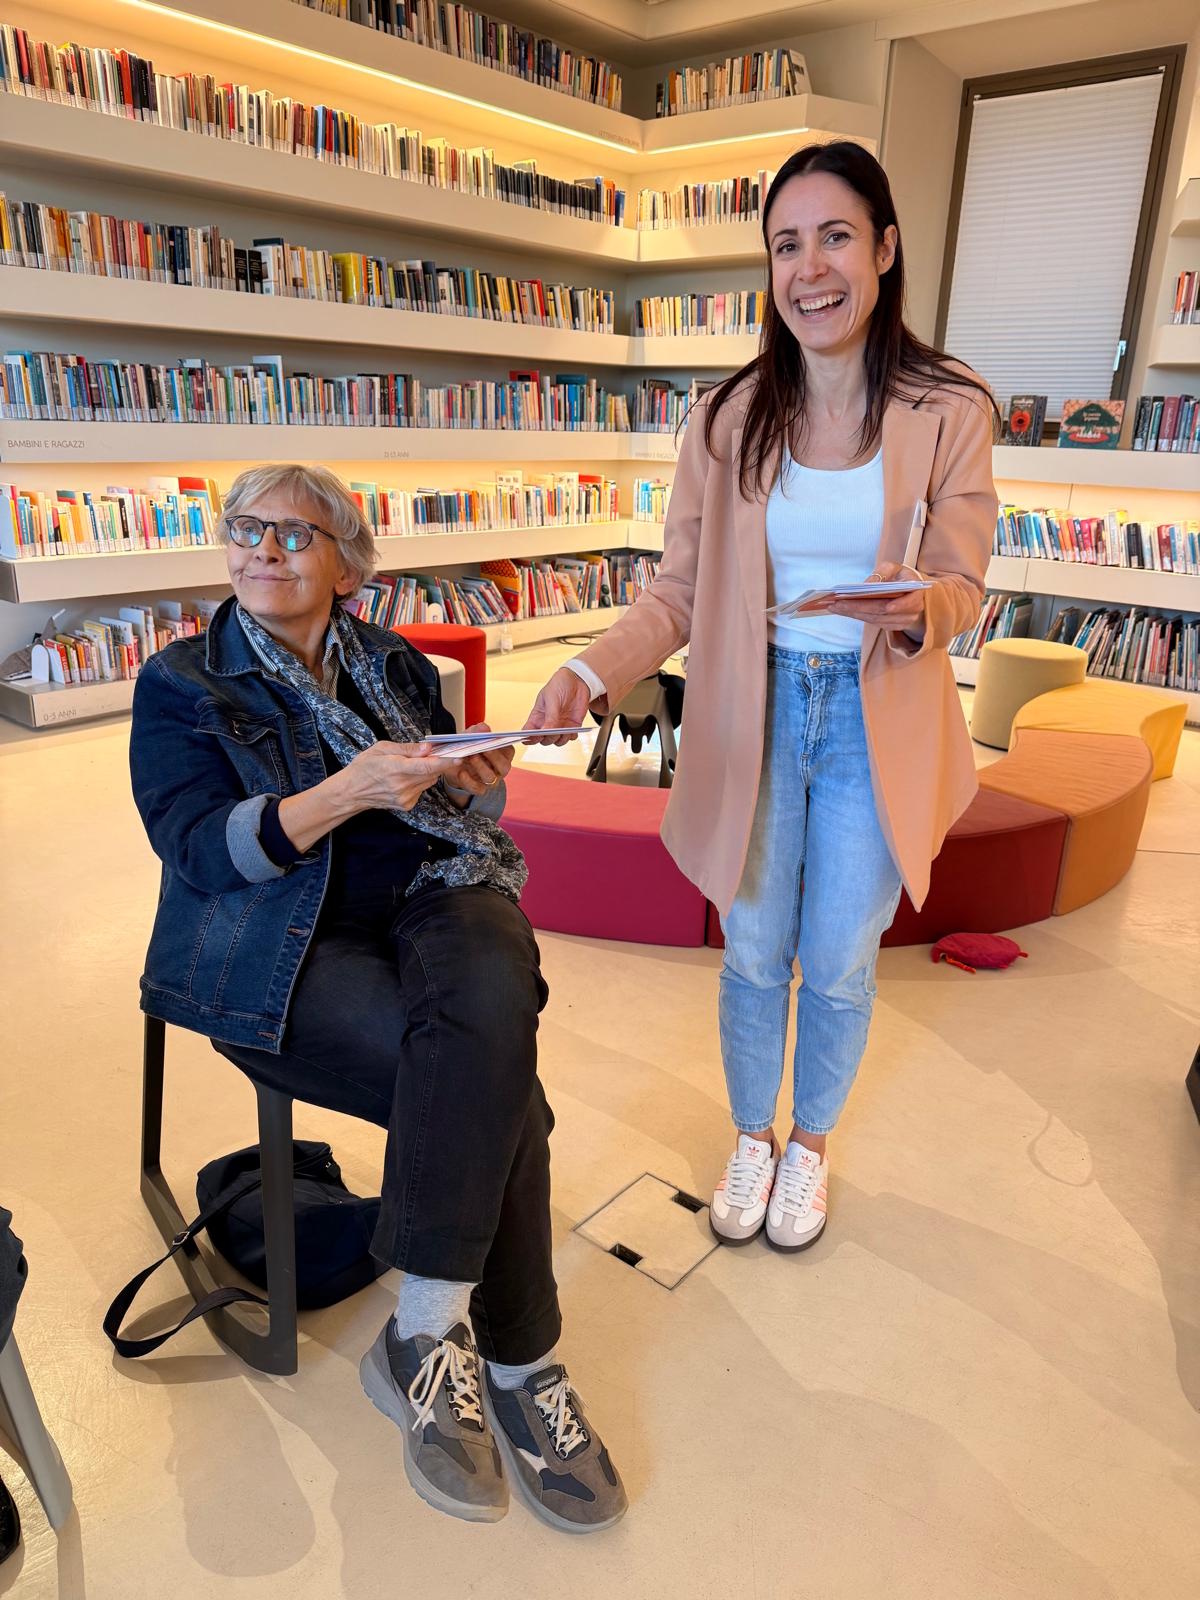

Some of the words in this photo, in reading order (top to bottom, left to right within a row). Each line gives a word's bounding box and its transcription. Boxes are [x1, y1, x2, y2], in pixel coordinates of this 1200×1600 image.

[7, 440, 42, 448] BAMBINI
[44, 440, 50, 448] E
[51, 440, 85, 448] RAGAZZI
[58, 709, 77, 720] ANNI
